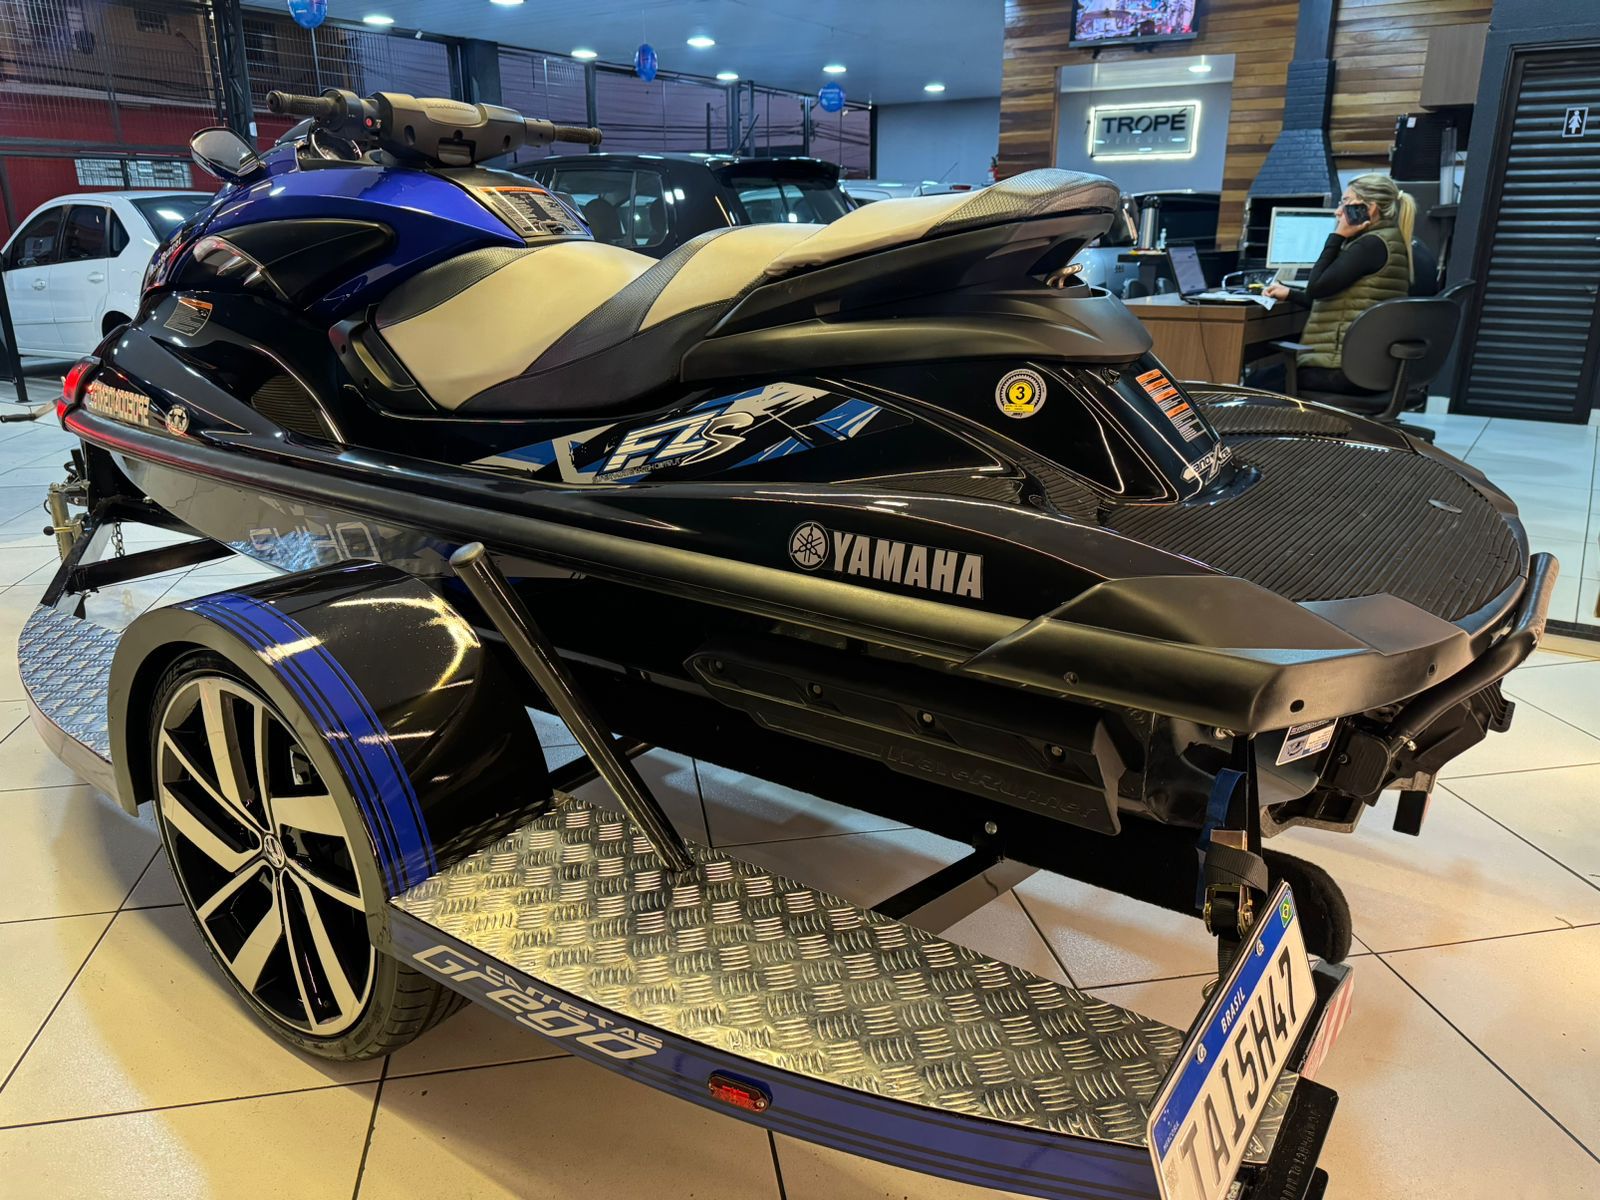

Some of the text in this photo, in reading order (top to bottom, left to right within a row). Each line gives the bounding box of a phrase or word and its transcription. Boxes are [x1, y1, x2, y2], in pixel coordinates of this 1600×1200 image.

[1101, 108, 1188, 134] TROPÉ
[1015, 386, 1025, 400] 3
[603, 409, 755, 472] FZS
[833, 531, 982, 599] YAMAHA
[1221, 986, 1247, 1034] BRASIL
[1177, 945, 1297, 1200] TAI5H47
